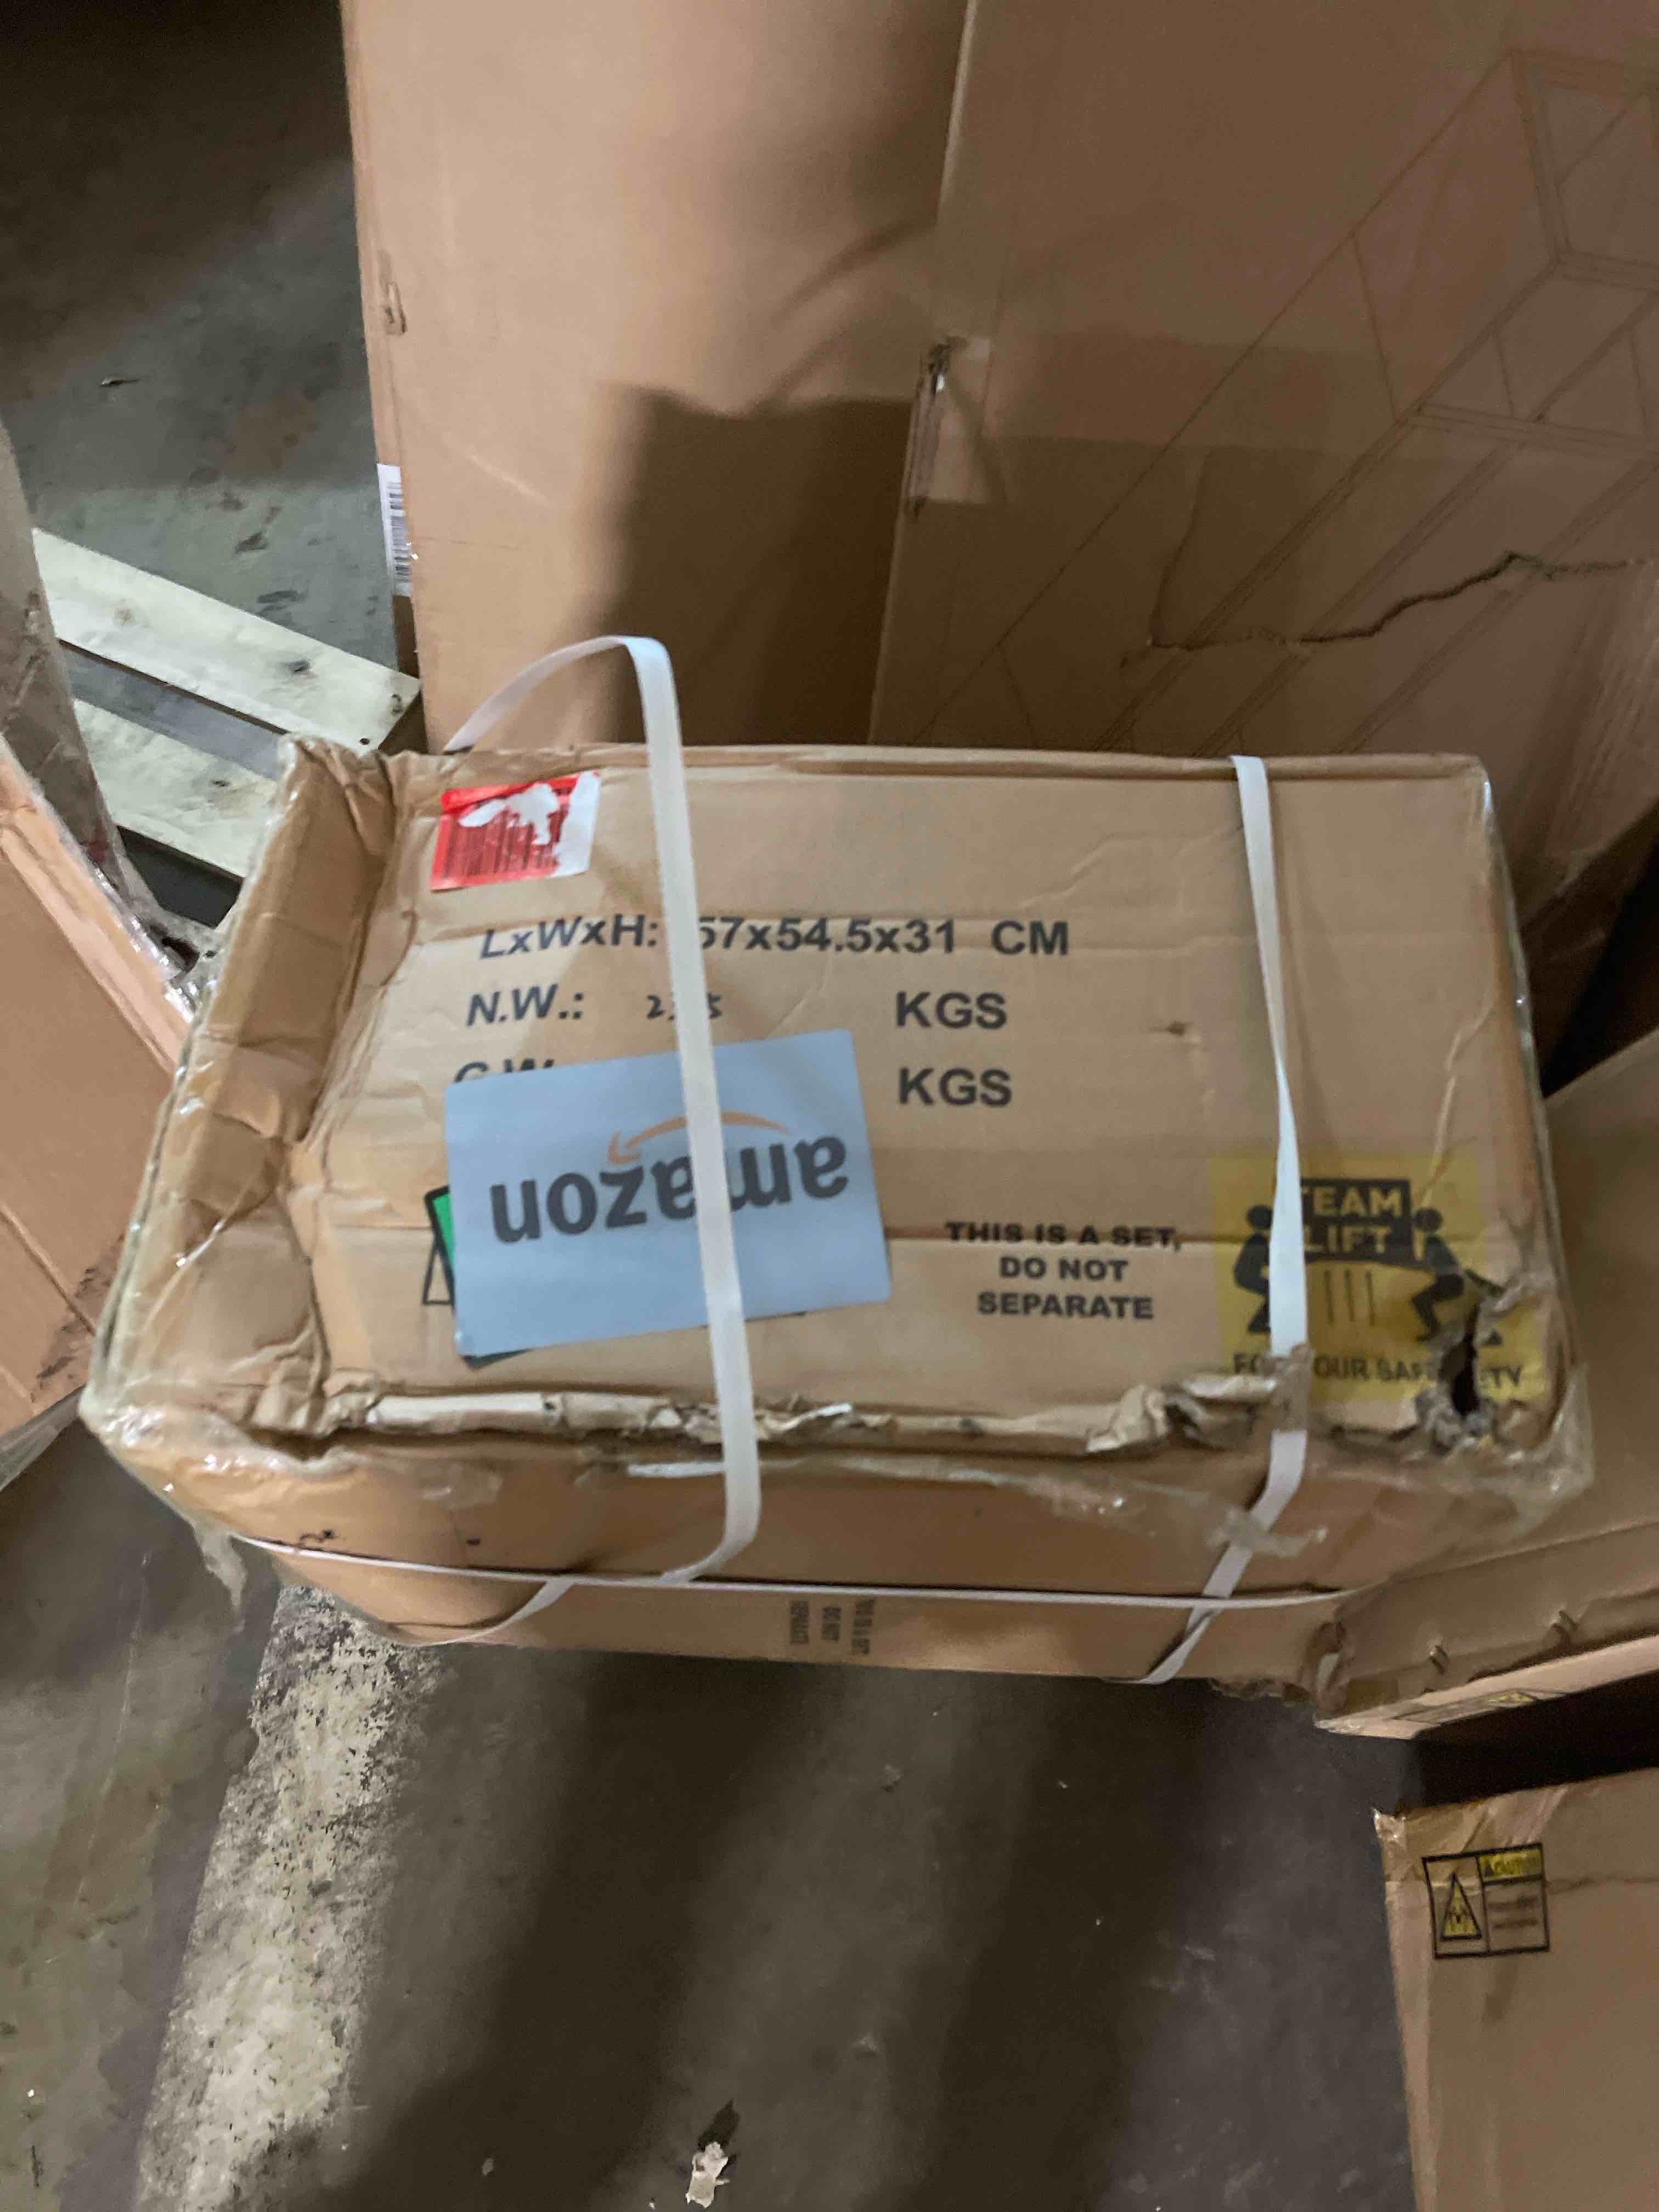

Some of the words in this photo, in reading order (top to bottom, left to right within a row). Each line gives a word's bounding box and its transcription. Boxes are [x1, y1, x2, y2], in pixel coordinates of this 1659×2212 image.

[480, 914, 658, 959] LxWxH:
[992, 921, 1068, 956] CM
[467, 984, 584, 1026] N.W.:
[896, 991, 1007, 1029] KGS
[898, 1067, 1012, 1108] KGS
[490, 1135, 849, 1243] amazon
[1301, 1186, 1403, 1217] EAM
[946, 1222, 1024, 1243] THIS
[1035, 1223, 1066, 1244] IS
[1079, 1226, 1099, 1245] A
[1112, 1226, 1182, 1252] SET,
[999, 1256, 1046, 1279] DO
[1059, 1259, 1128, 1282] NOT
[977, 1290, 1154, 1320] SEPARATE
[1314, 1356, 1369, 1379] OUR
[1377, 1357, 1523, 1387] SAFTY
